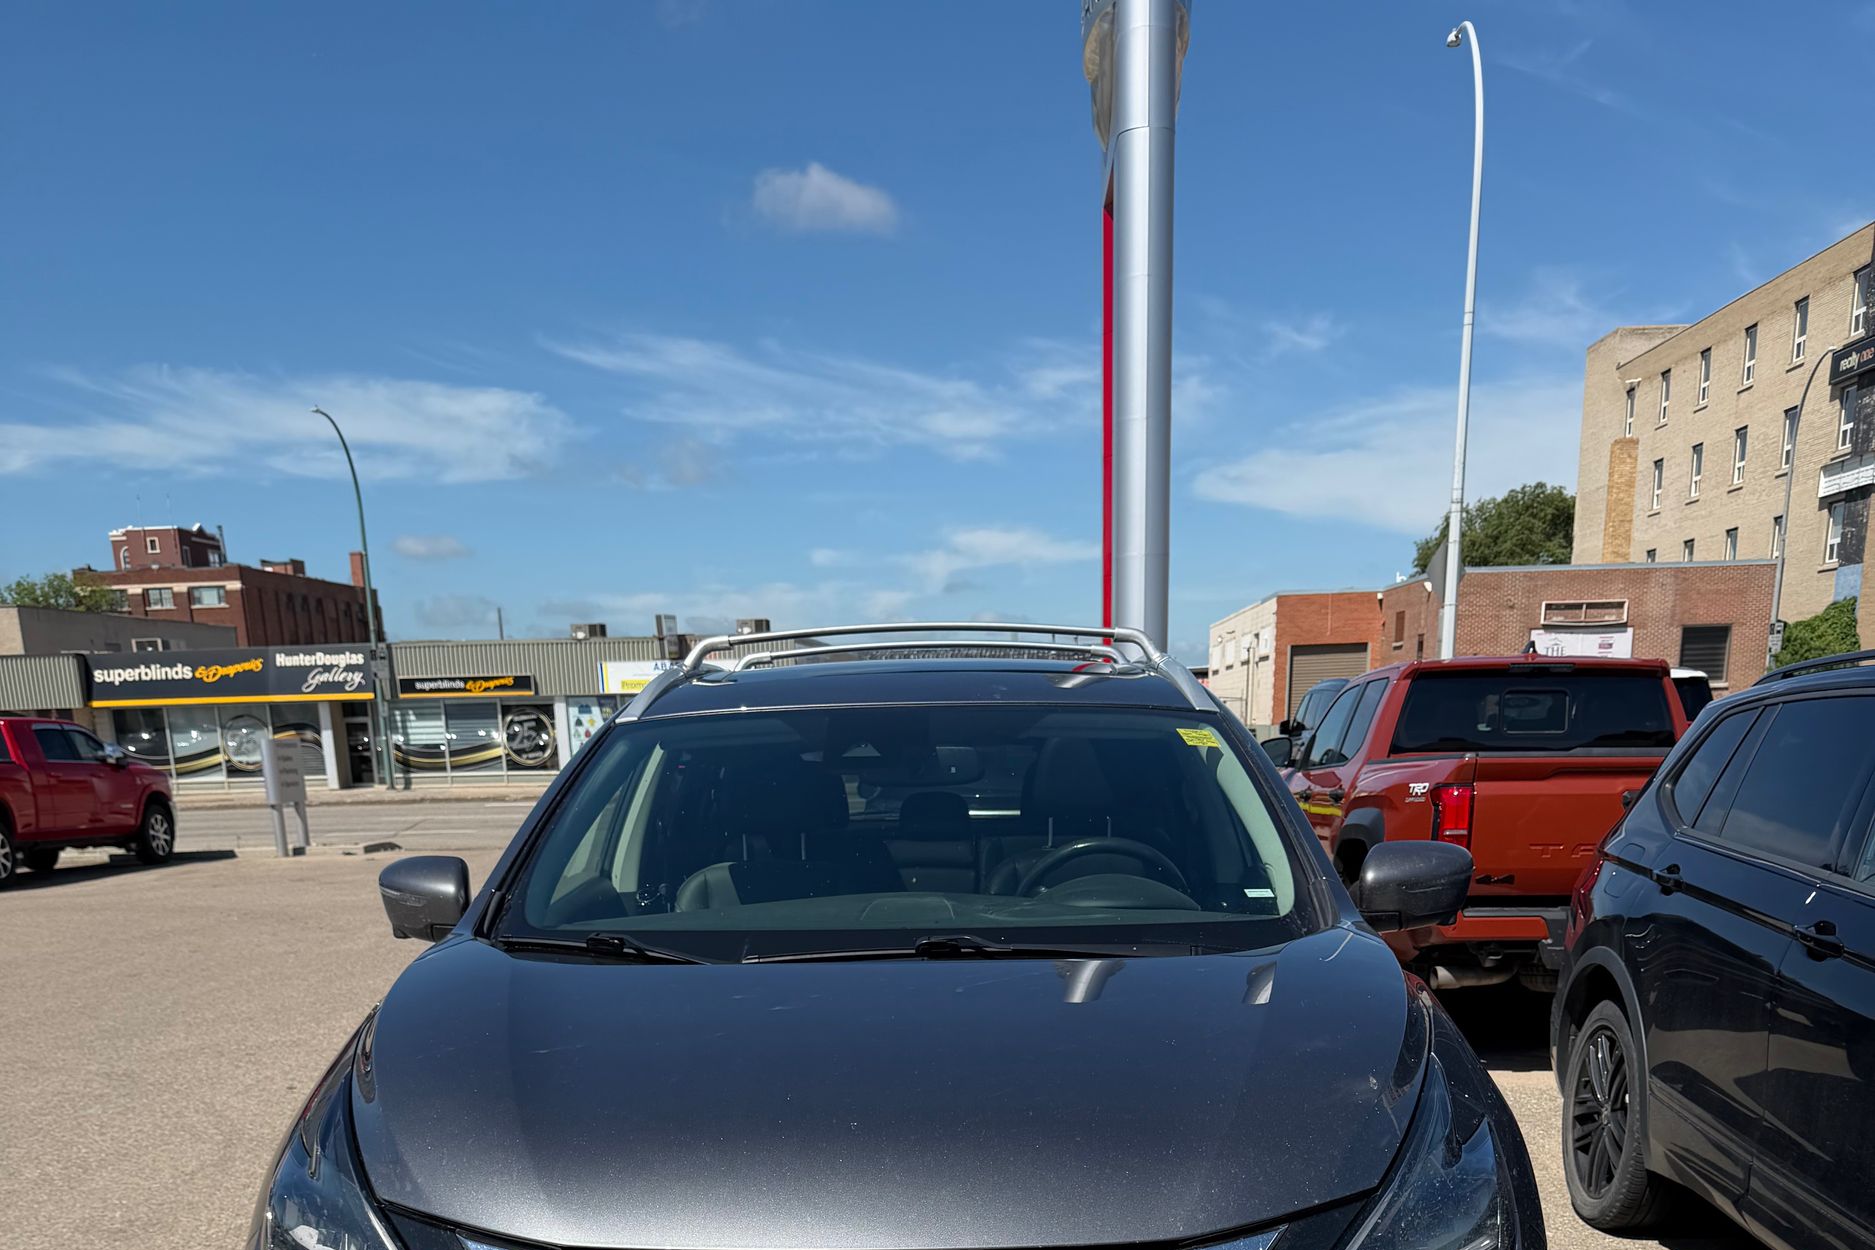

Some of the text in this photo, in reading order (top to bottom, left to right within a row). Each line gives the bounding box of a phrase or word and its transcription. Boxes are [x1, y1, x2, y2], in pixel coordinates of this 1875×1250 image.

[1544, 646, 1565, 657] THE
[94, 662, 193, 685] superblinds
[301, 666, 364, 693] Gallery
[414, 679, 465, 691] superblinds
